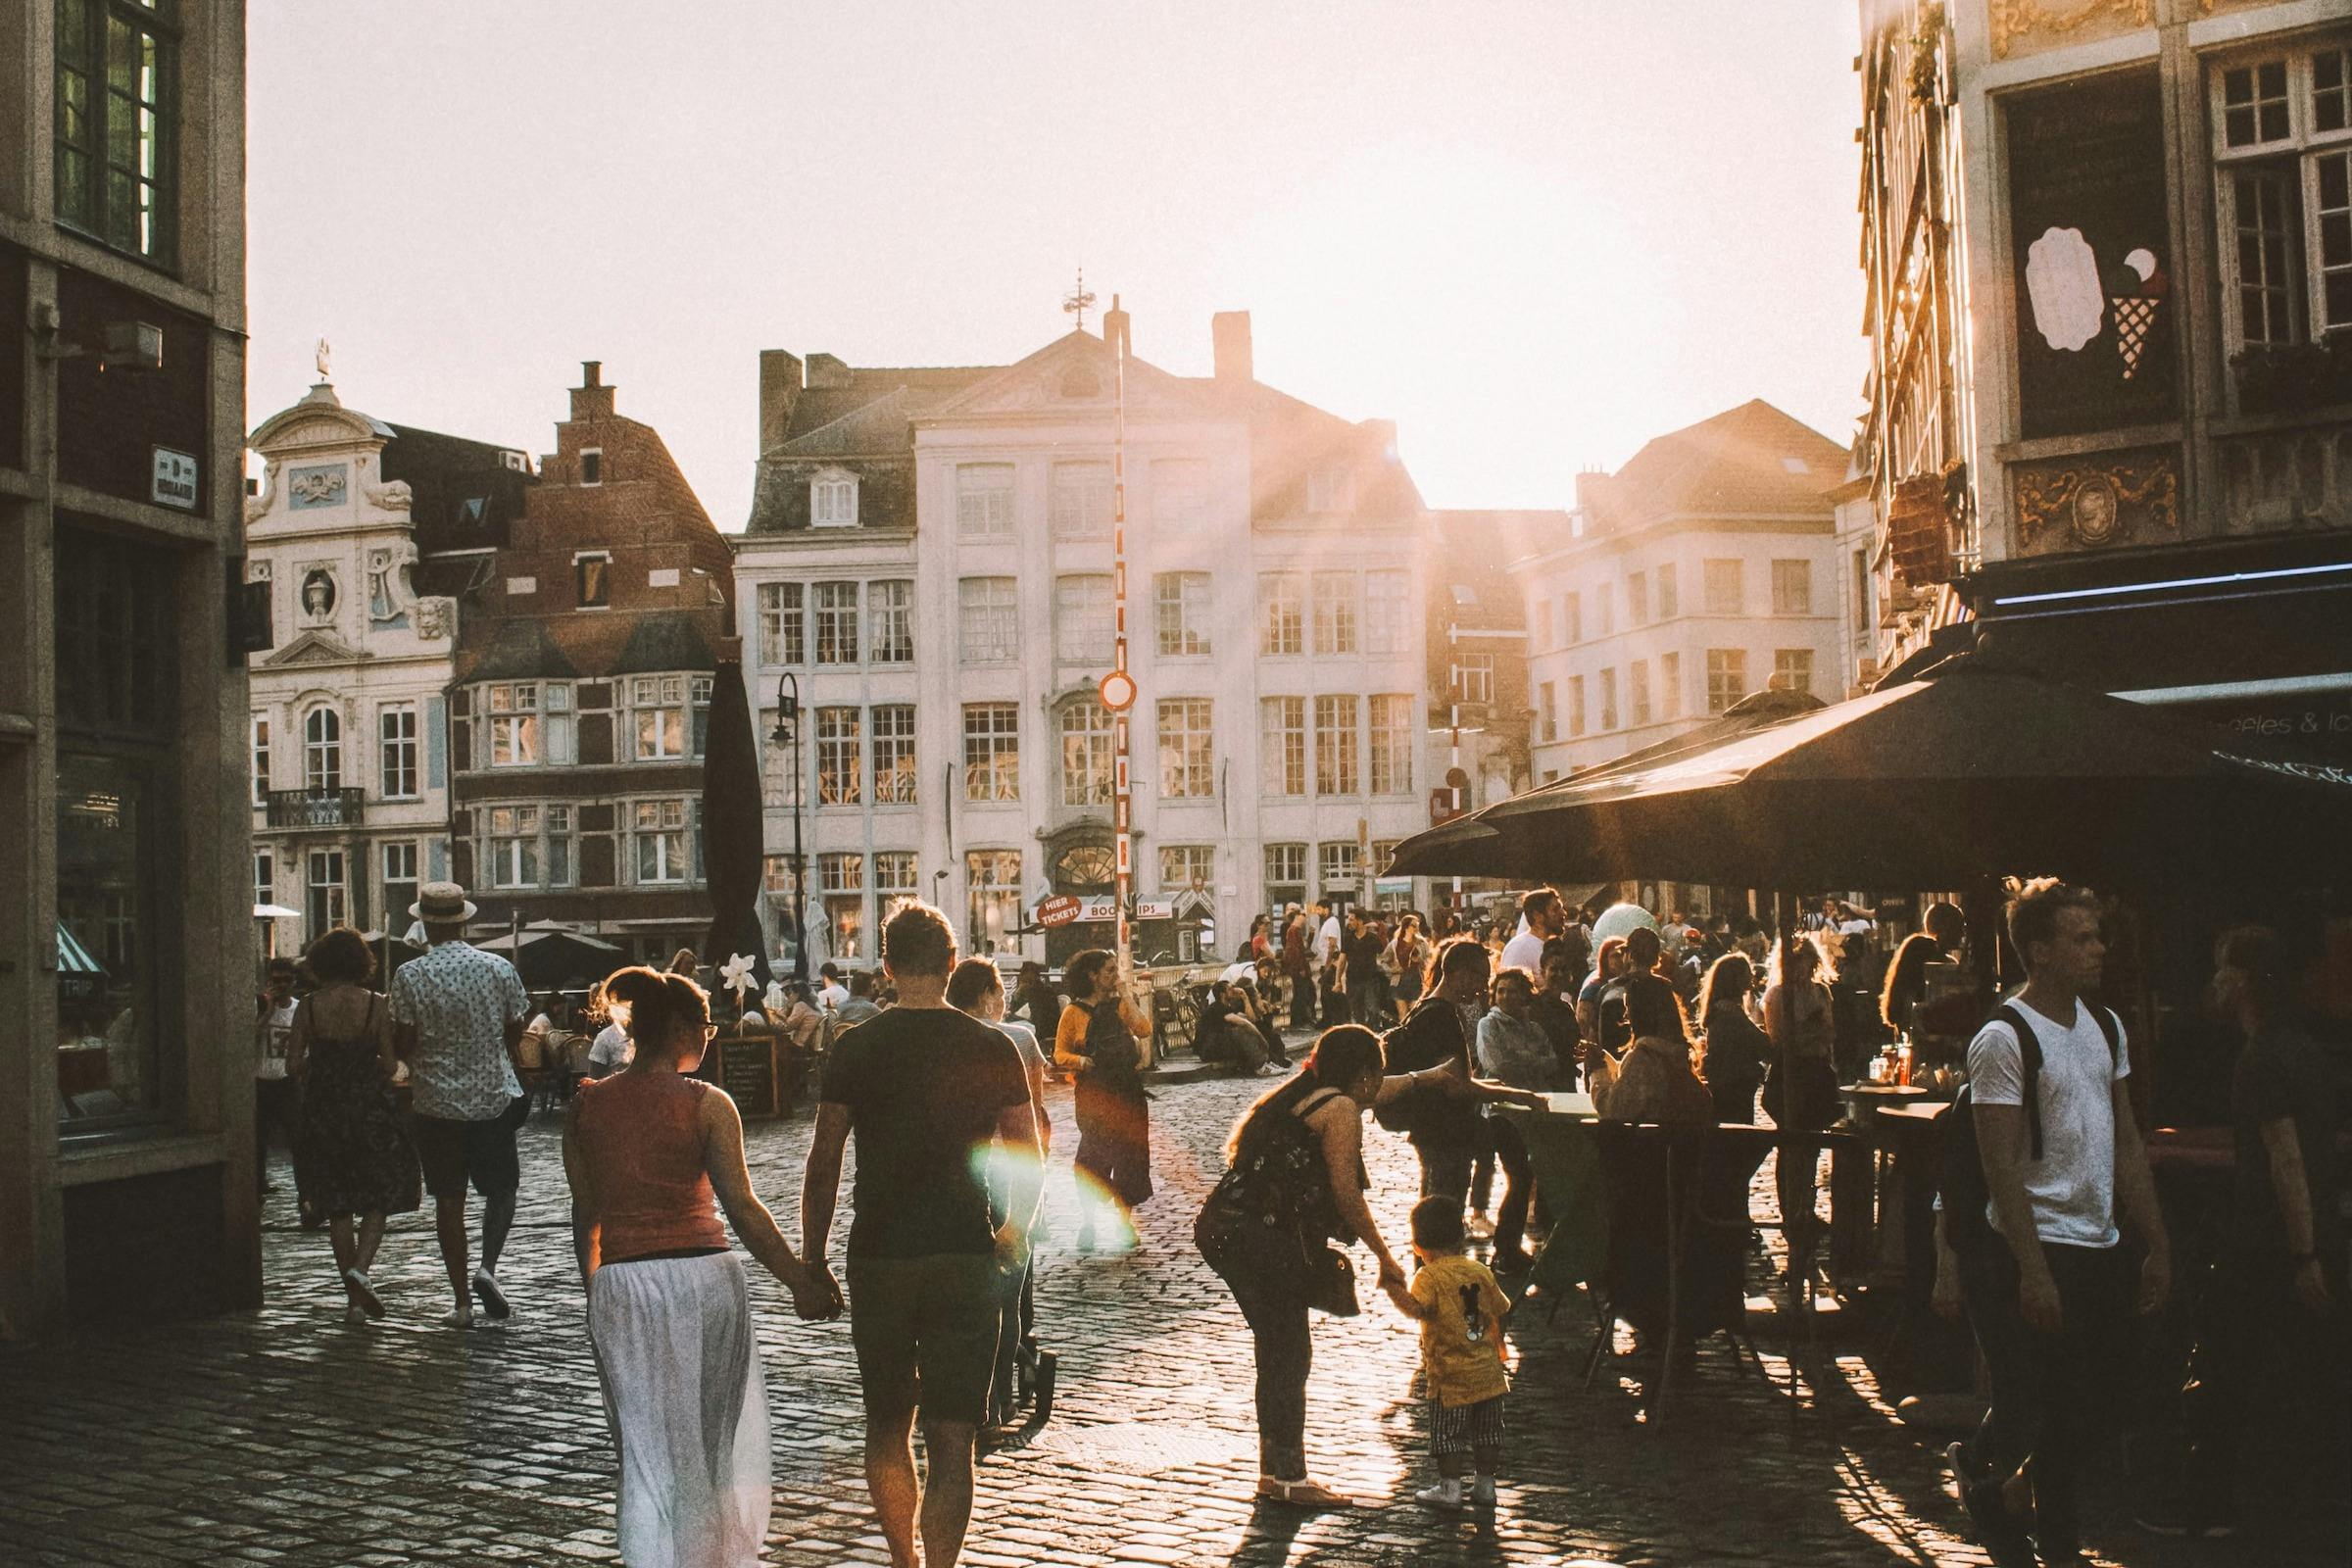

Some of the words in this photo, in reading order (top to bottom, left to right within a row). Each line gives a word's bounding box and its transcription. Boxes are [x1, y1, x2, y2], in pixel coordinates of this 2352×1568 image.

[2300, 711, 2319, 734] &
[1045, 897, 1068, 910] HIER
[1042, 906, 1079, 925] TICKETS
